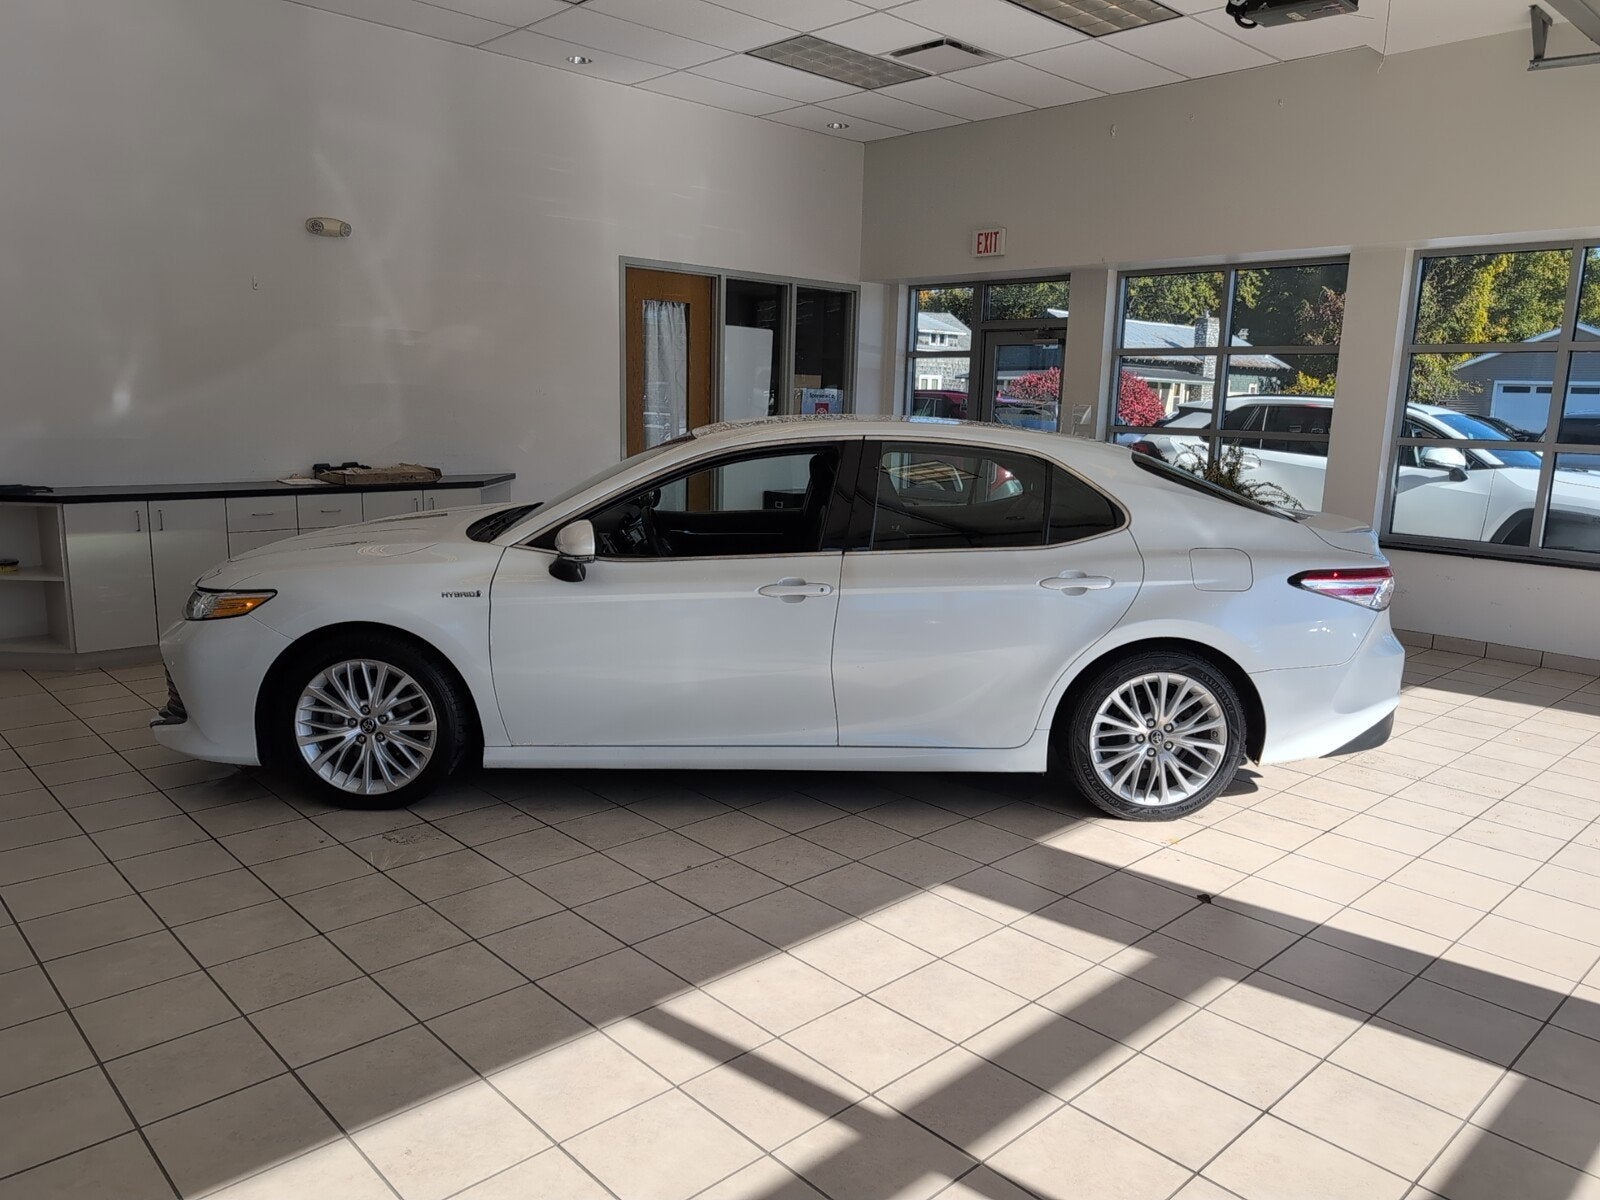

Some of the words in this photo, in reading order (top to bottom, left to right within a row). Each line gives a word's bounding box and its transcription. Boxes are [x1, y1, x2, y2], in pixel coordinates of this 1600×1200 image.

[977, 231, 999, 254] EXIT
[1199, 672, 1235, 714] ASSURANCE
[1081, 763, 1121, 807] GOODYEAR
